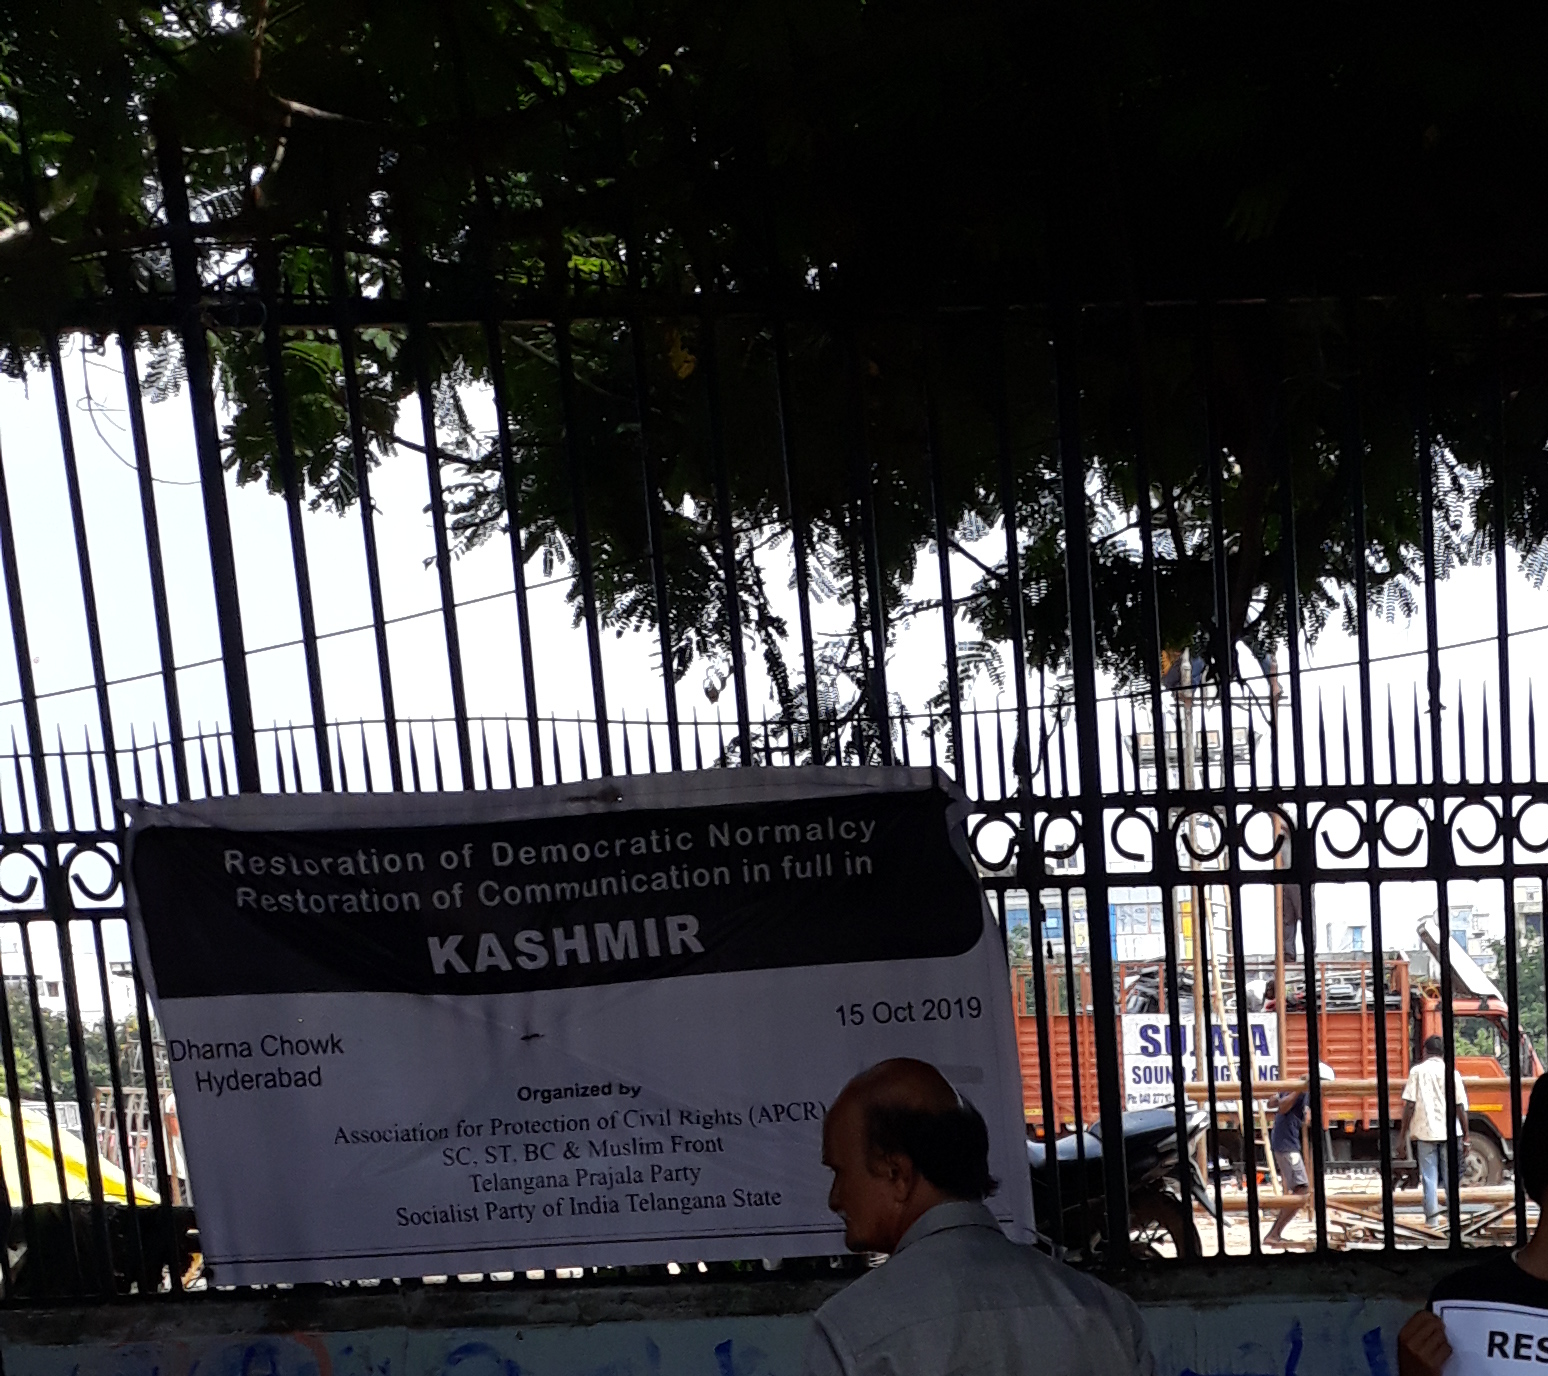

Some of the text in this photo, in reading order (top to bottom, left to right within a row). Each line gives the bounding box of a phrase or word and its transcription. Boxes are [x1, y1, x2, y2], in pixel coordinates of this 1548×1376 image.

[439, 842, 474, 870] of
[491, 828, 694, 867] Democratic
[707, 816, 877, 849] Normalcy
[235, 850, 874, 915] Restoration of Communication in full in
[426, 914, 706, 976] KASHMIR
[835, 996, 983, 1027] 15 Oct 2019
[259, 1033, 345, 1058] Chowk
[194, 1065, 323, 1098] Hyderabad
[516, 1082, 643, 1104] Organized by
[334, 1121, 449, 1145] Association
[456, 1119, 484, 1139] for
[489, 1115, 591, 1137] Protection
[596, 1110, 620, 1130] of
[623, 1108, 672, 1130] Civil
[679, 1108, 744, 1131] Rights
[523, 1142, 556, 1162] BC
[562, 1140, 581, 1160] &
[588, 1137, 664, 1158] Muslim
[670, 1134, 725, 1154] Front
[468, 1164, 702, 1195] Telangana Prajala Party
[395, 1188, 783, 1227] Socialist Party of India Telangana State
